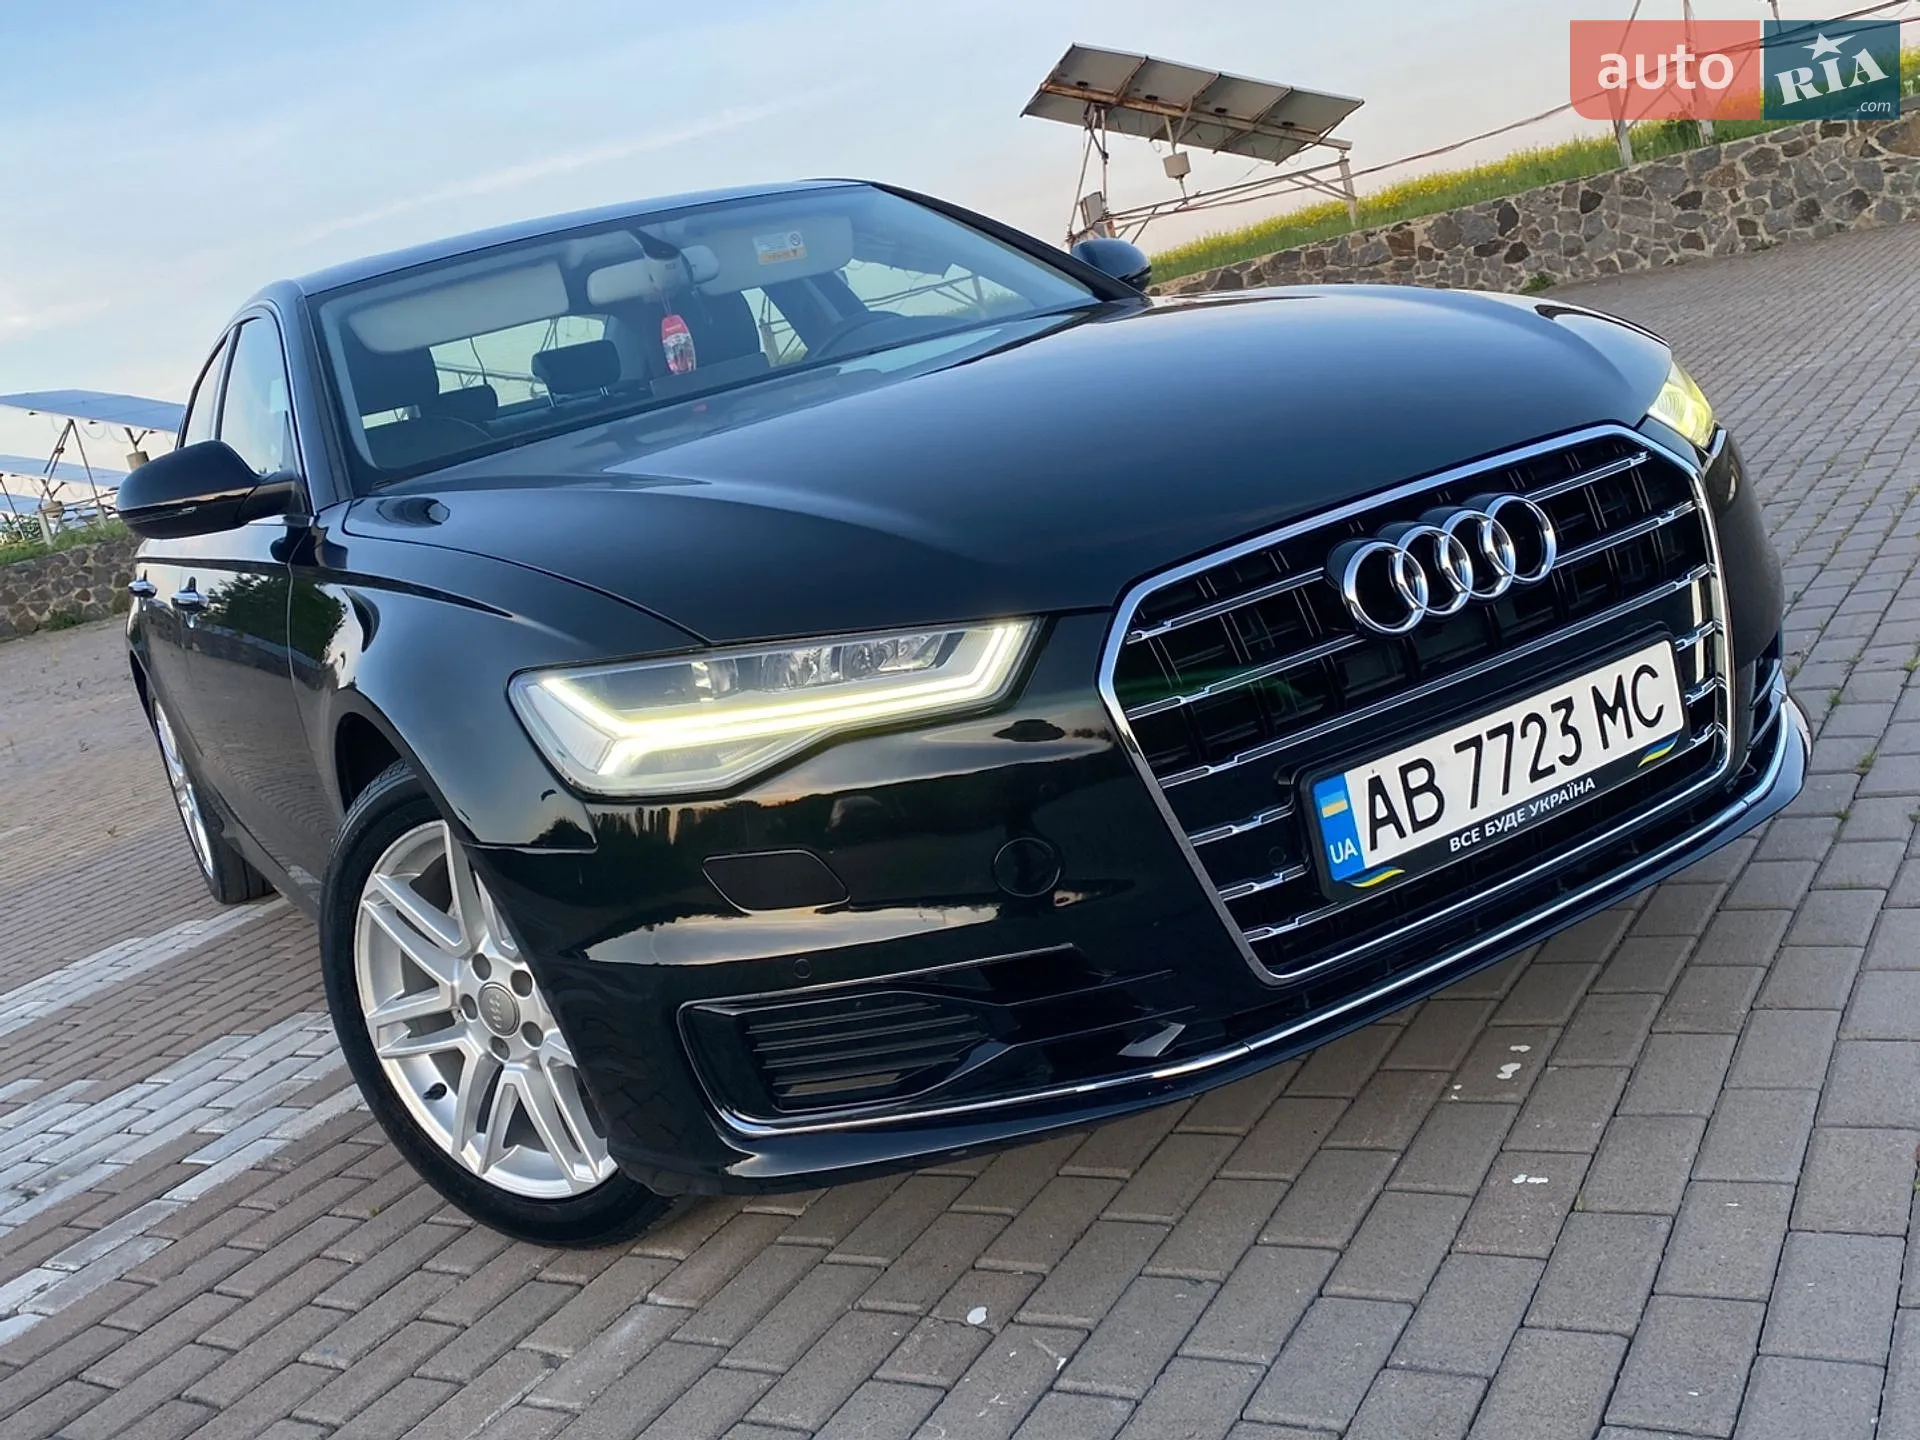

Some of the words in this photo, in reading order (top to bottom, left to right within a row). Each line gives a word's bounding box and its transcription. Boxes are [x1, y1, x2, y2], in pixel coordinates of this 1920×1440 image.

[1368, 756, 1446, 852] AB
[1453, 697, 1583, 810] 7723
[1590, 664, 1665, 751] MC
[1330, 838, 1359, 865] UA
[1449, 827, 1481, 853] ВСЕ
[1484, 808, 1527, 837] БУДЕ
[1528, 777, 1597, 817] УКРАЇНА
